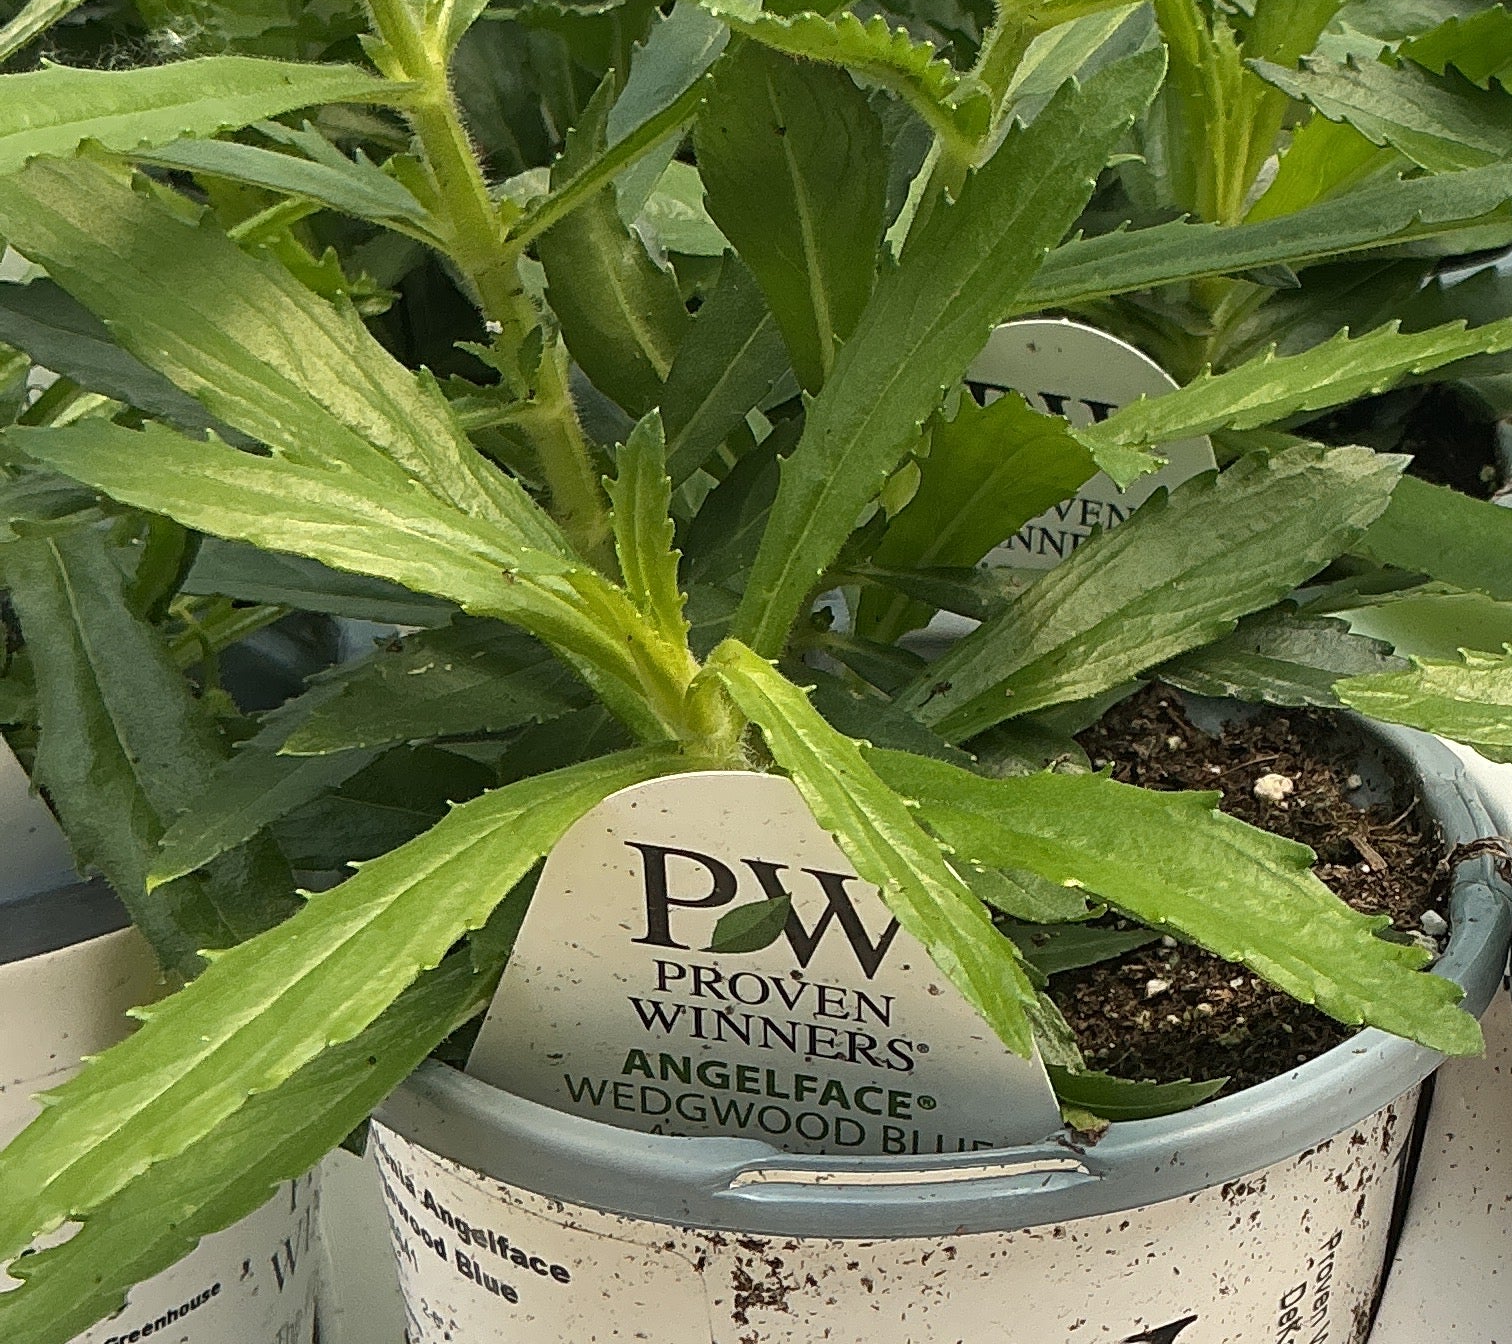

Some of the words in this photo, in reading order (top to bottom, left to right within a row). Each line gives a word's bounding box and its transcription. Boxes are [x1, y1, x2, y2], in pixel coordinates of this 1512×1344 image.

[624, 841, 902, 979] PW
[652, 959, 896, 1027] PROVEN
[564, 1073, 866, 1147] WEDGWOOD
[423, 1188, 572, 1284] Angelface
[455, 1248, 519, 1305] Blue
[1311, 1229, 1343, 1327] Proven
